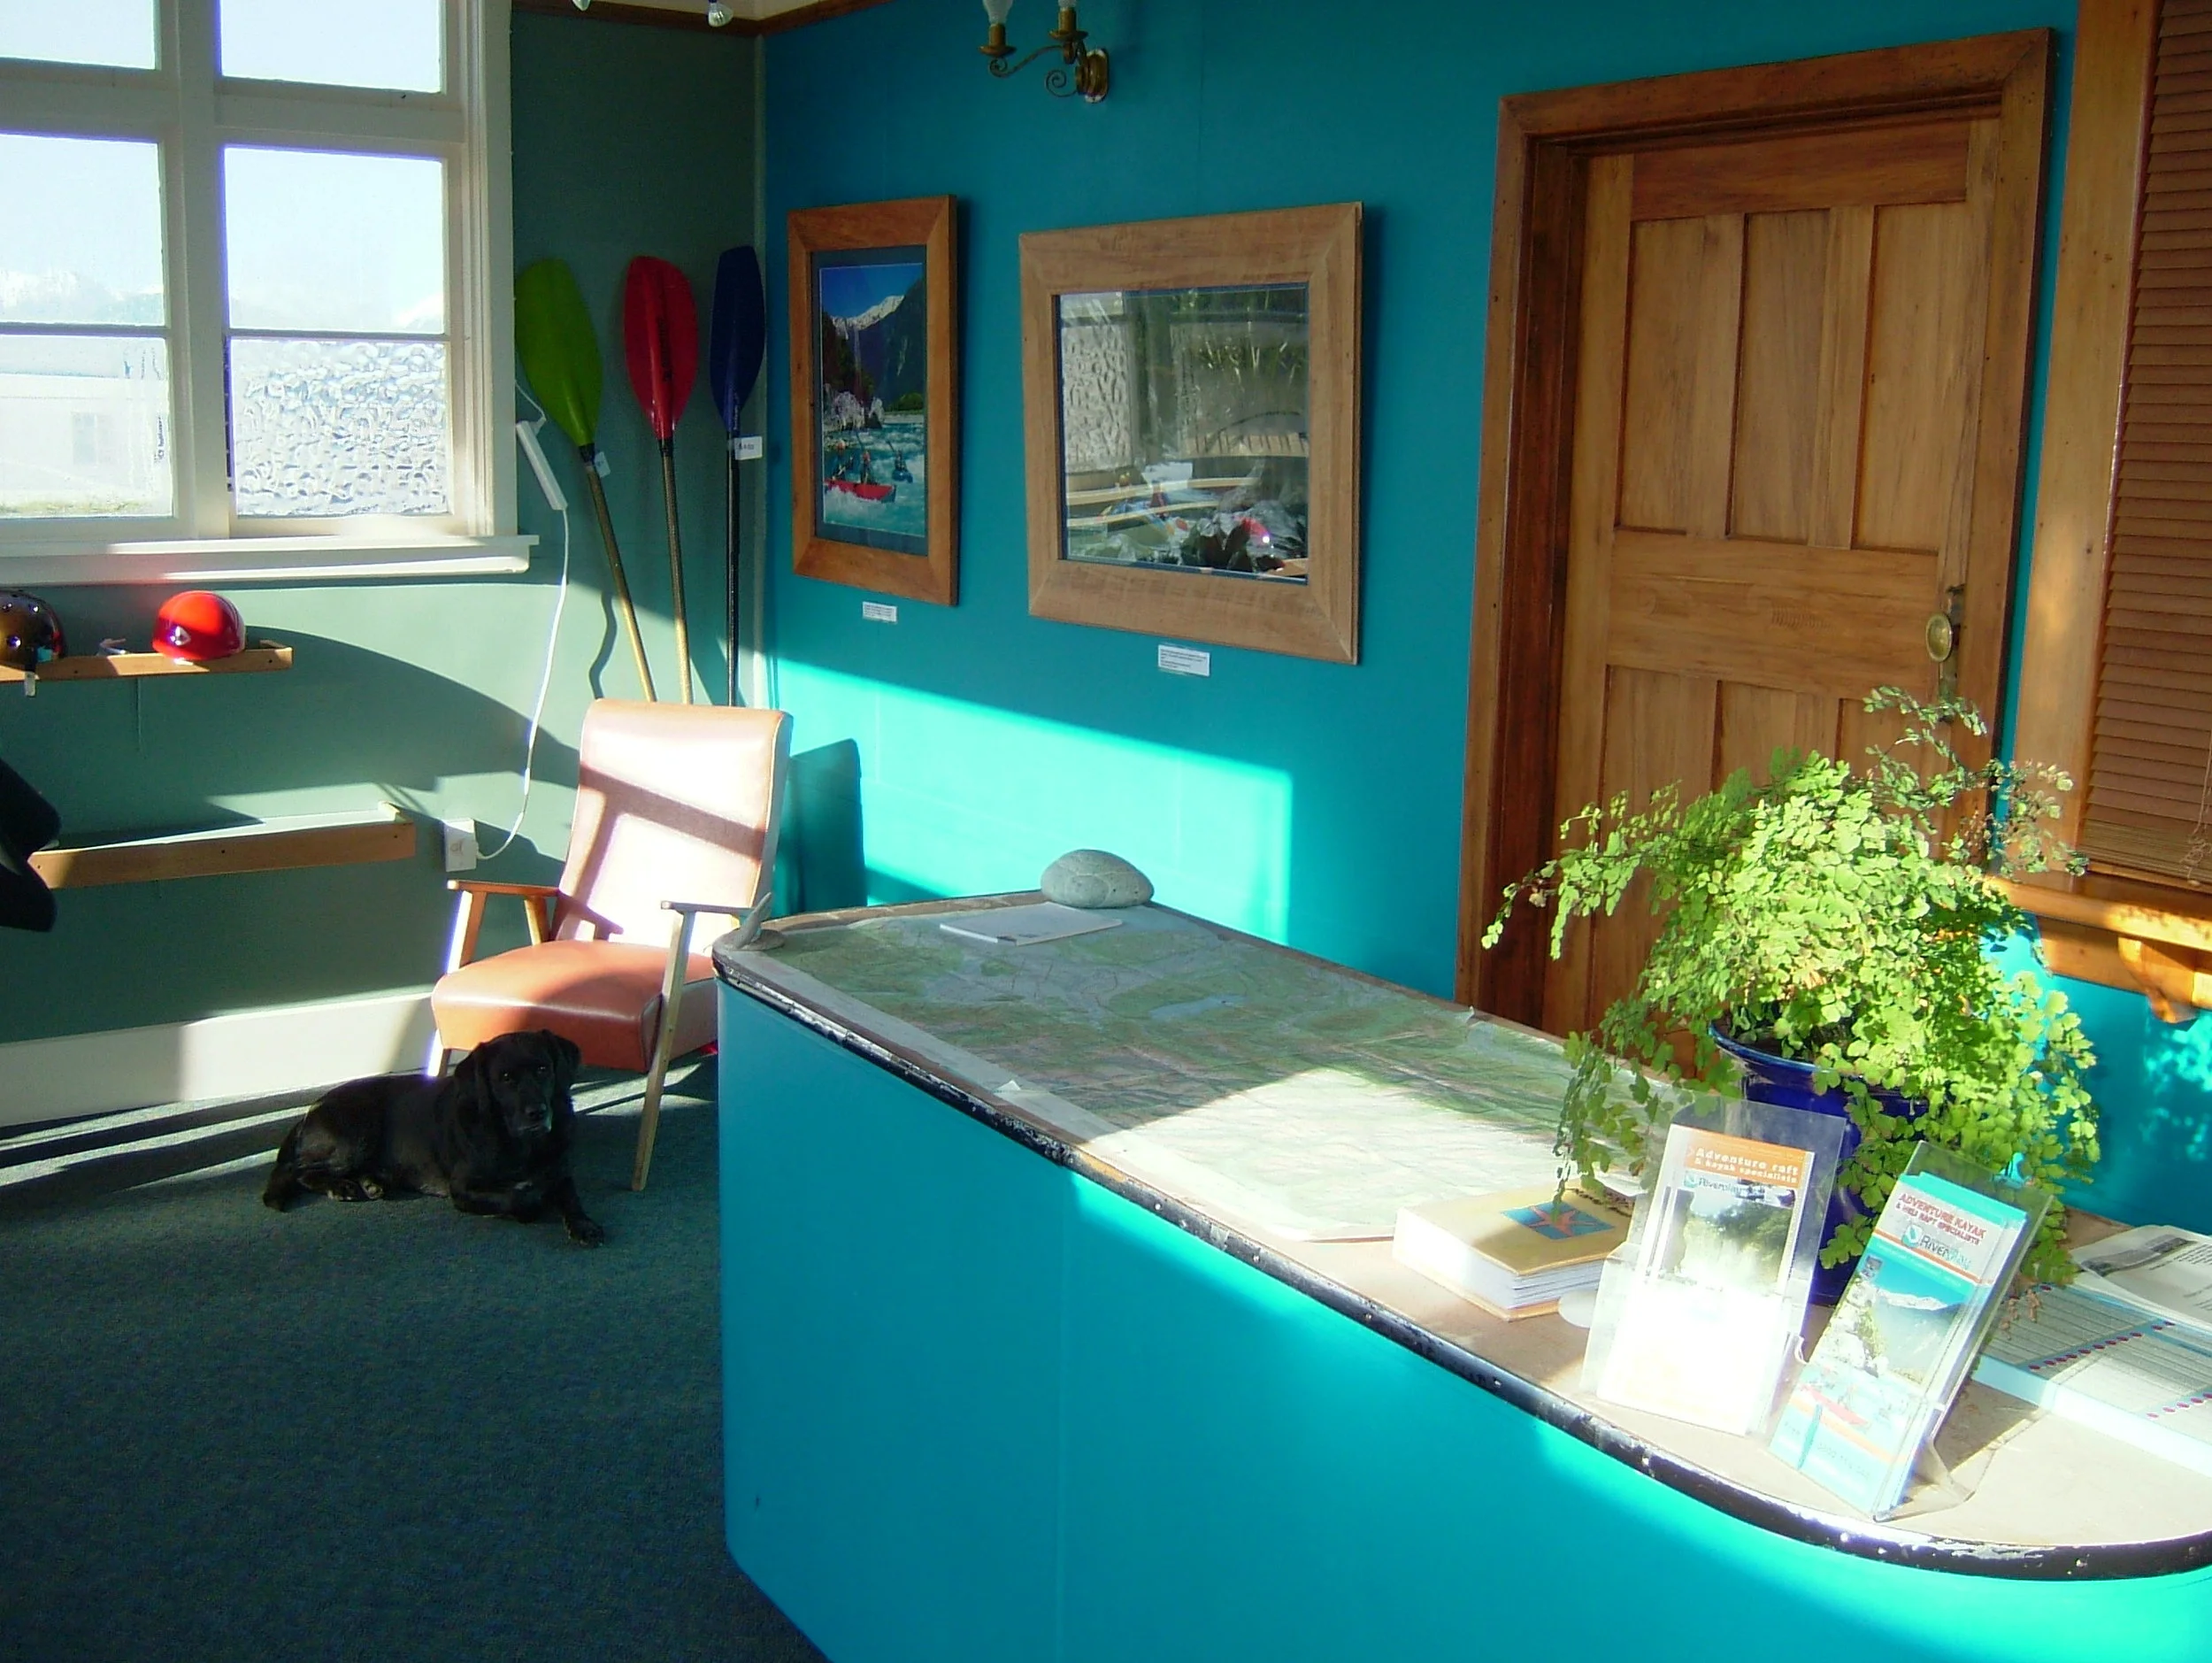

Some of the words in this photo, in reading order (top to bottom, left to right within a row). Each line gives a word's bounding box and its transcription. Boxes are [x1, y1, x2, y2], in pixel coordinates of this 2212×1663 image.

[1695, 1147, 1767, 1169] Adventure
[1771, 1164, 1799, 1175] raft
[1705, 1159, 1736, 1171] kayak
[1740, 1167, 1798, 1183] specialists
[1899, 1193, 1955, 1223] ADVENTURE
[1954, 1218, 1986, 1239] KAYAK
